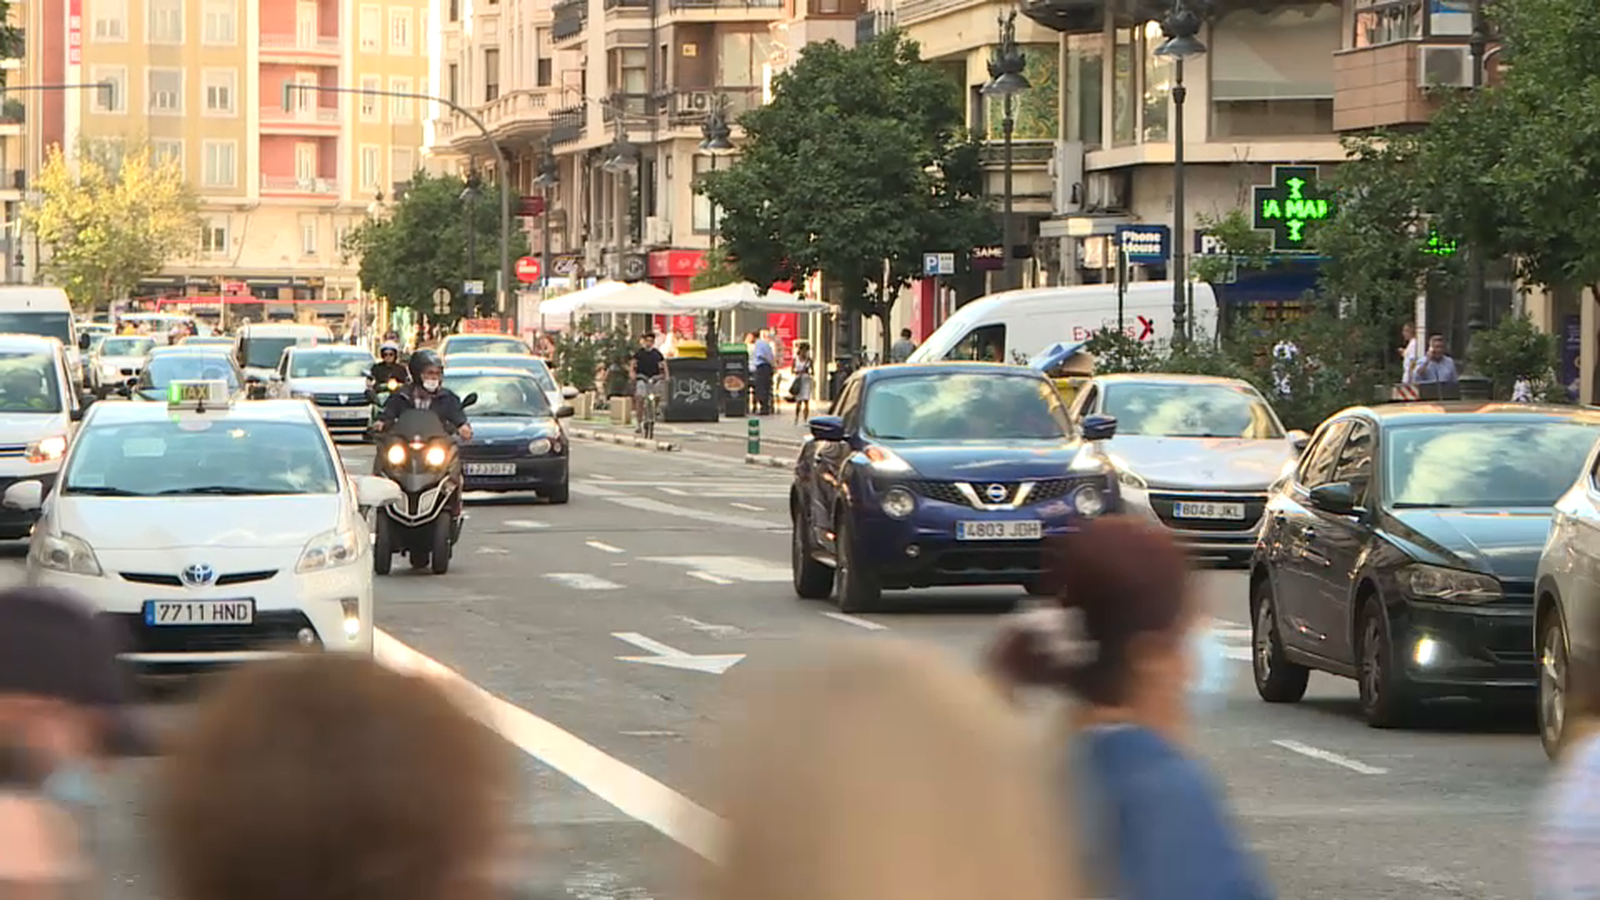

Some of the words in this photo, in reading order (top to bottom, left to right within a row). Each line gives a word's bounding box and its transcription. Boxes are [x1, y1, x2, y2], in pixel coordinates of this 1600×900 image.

[1122, 231, 1161, 243] Phone
[1122, 243, 1161, 253] House
[926, 256, 937, 271] P
[1073, 326, 1137, 341] Expss
[1218, 506, 1242, 517] JKL
[967, 523, 1004, 537] 4803
[1009, 523, 1038, 537] JDH
[160, 604, 204, 621] 7711
[212, 604, 248, 621] HND
